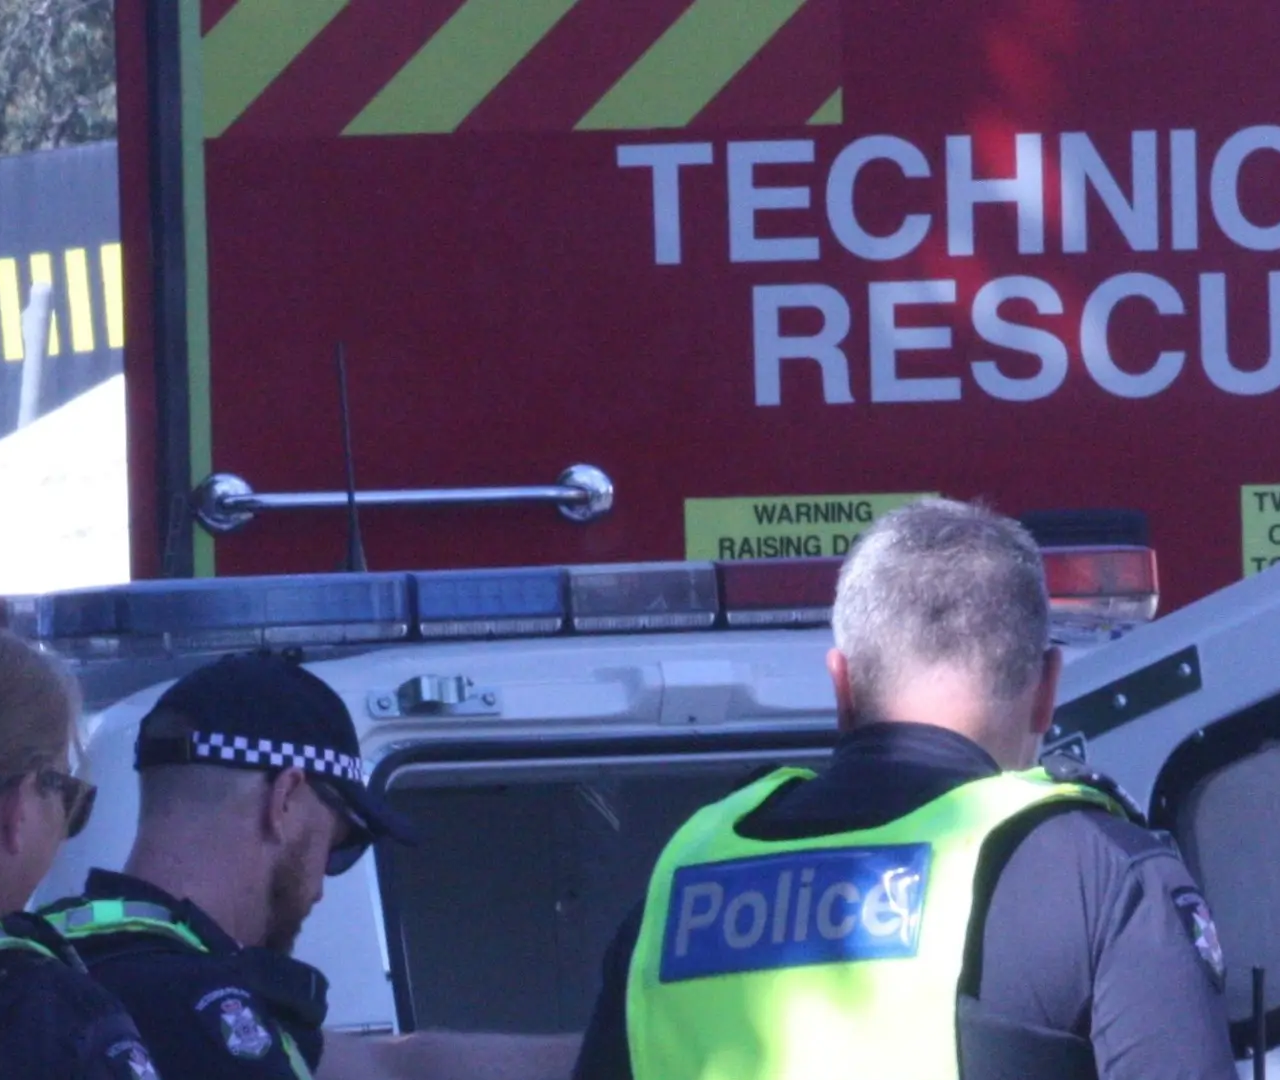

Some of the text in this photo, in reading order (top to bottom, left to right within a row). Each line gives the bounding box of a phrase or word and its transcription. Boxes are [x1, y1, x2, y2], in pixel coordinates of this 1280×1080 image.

[752, 501, 873, 525] WARNING
[719, 534, 821, 560] RAISING
[673, 867, 920, 957] Police
